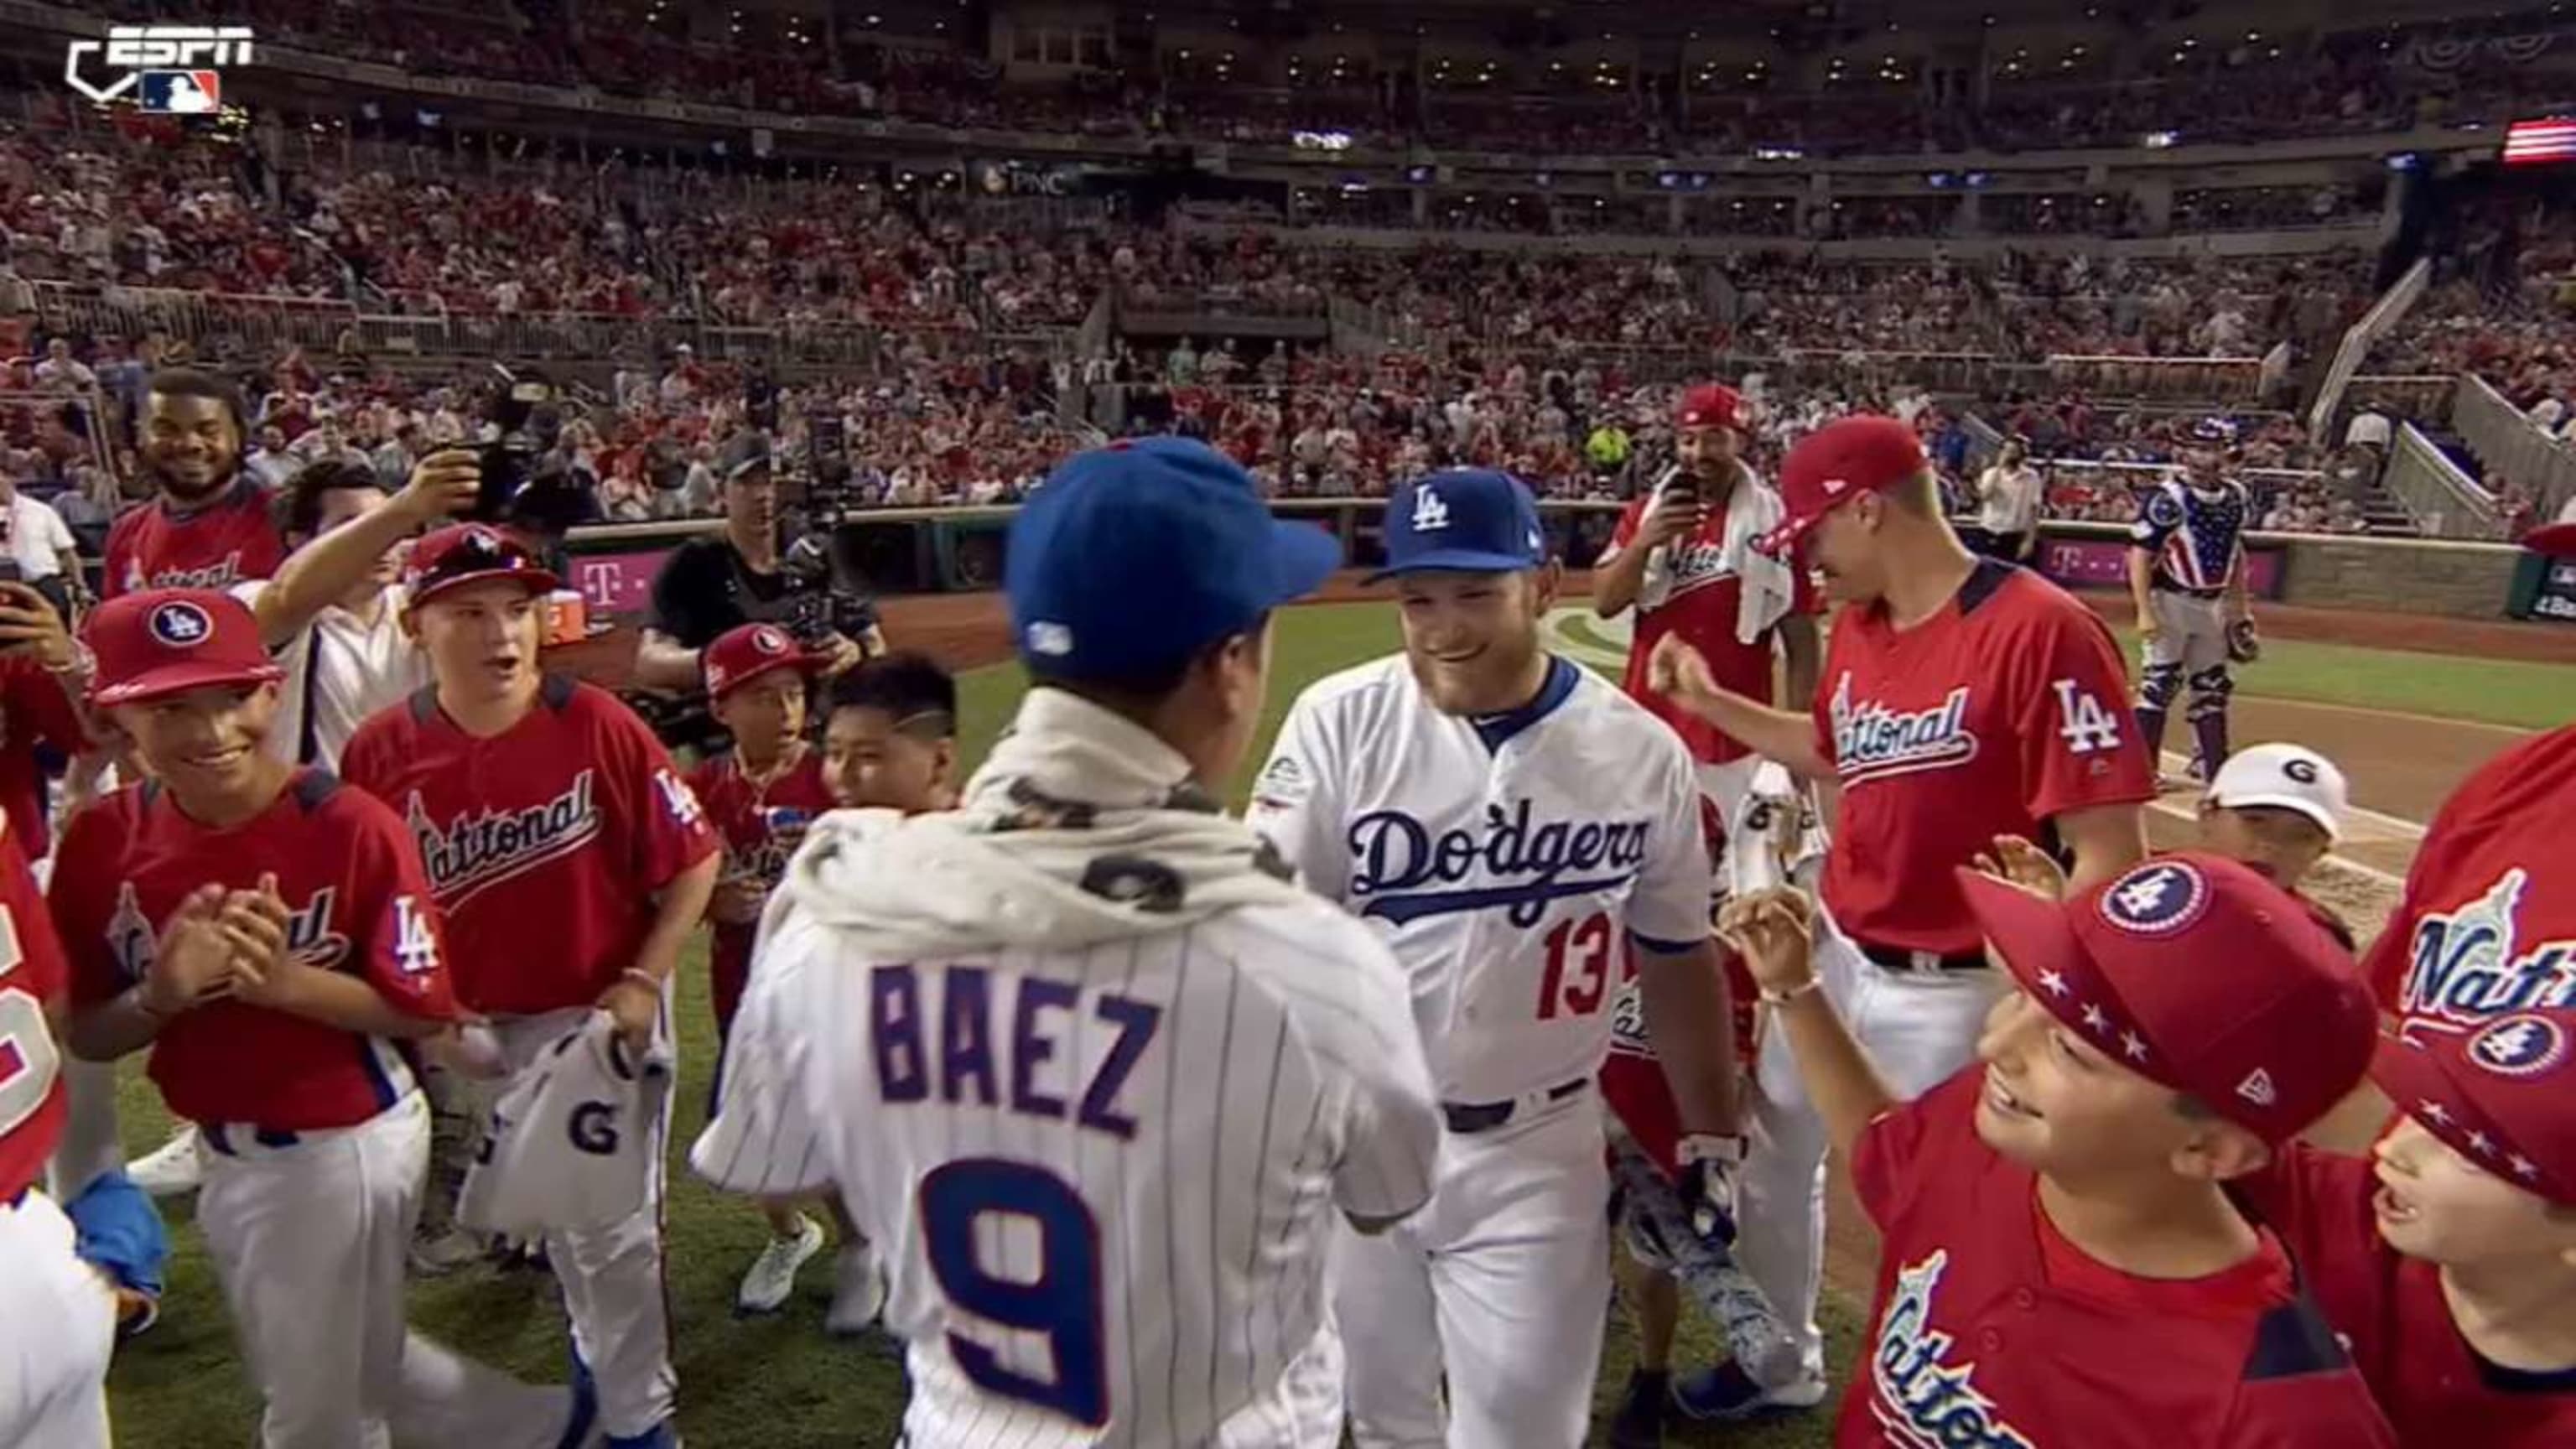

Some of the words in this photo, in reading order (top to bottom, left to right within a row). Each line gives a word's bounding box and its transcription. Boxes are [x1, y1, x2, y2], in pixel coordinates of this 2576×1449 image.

[1013, 171, 1066, 195] PNC
[1413, 484, 1449, 531] LA
[164, 608, 200, 637] LA
[2051, 678, 2122, 753] LA
[2282, 759, 2318, 786] G
[1348, 798, 1650, 928] Dodgers
[394, 896, 439, 972] LA
[1536, 911, 1613, 1021] 13
[871, 962, 1162, 1142] BAEZ
[569, 1101, 621, 1156] G
[919, 1155, 1112, 1431] 9
